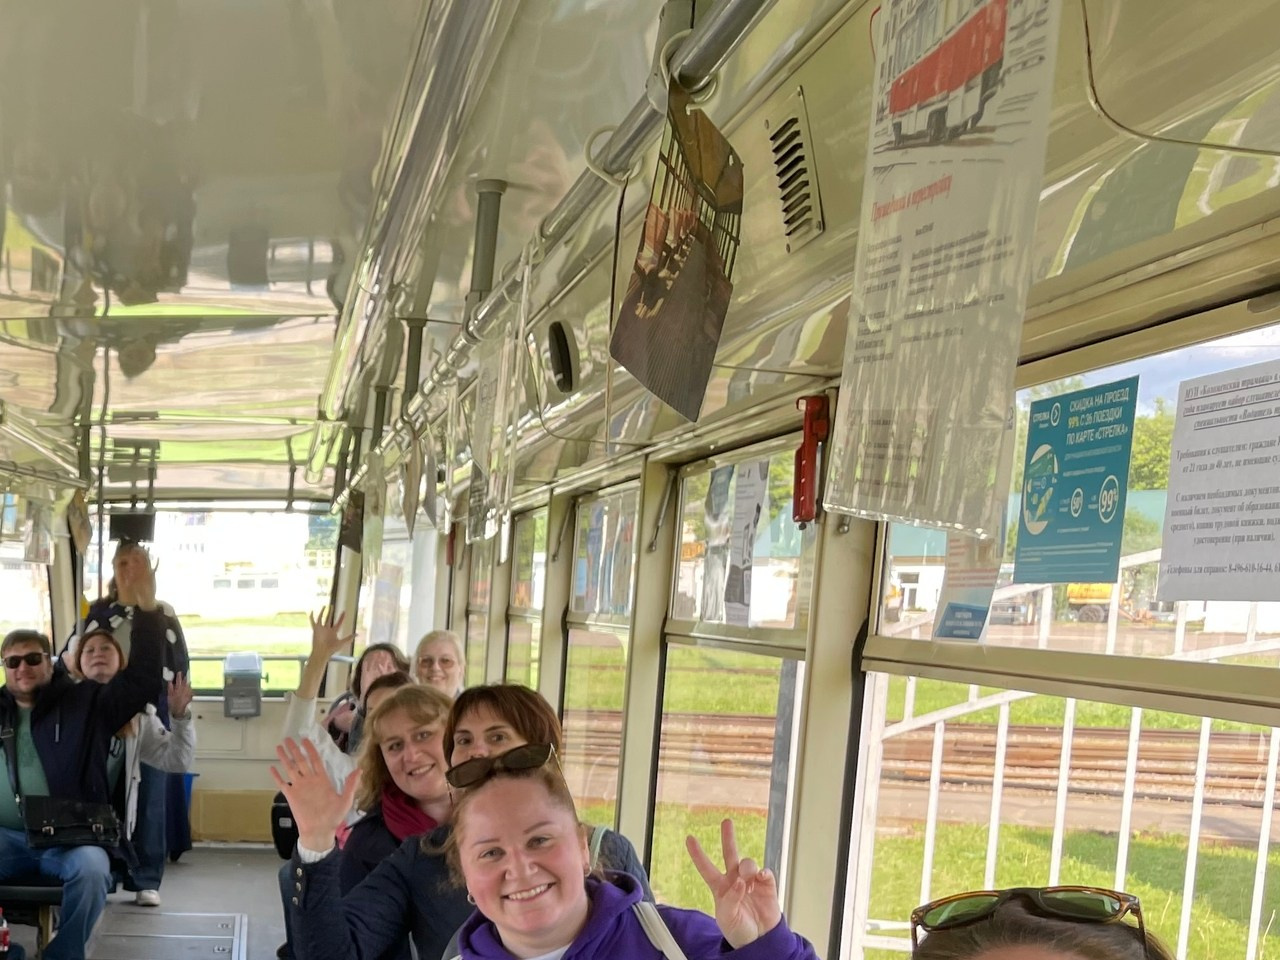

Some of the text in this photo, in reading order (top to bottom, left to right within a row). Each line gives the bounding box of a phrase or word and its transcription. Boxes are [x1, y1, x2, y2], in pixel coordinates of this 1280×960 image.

[1069, 387, 1130, 413] СКИДКА НА ПРОЕЗД
[1093, 406, 1123, 423] ПОЕЗДКИ
[1065, 424, 1128, 446] ПО КАРТЕ «СТРЕЛКА»
